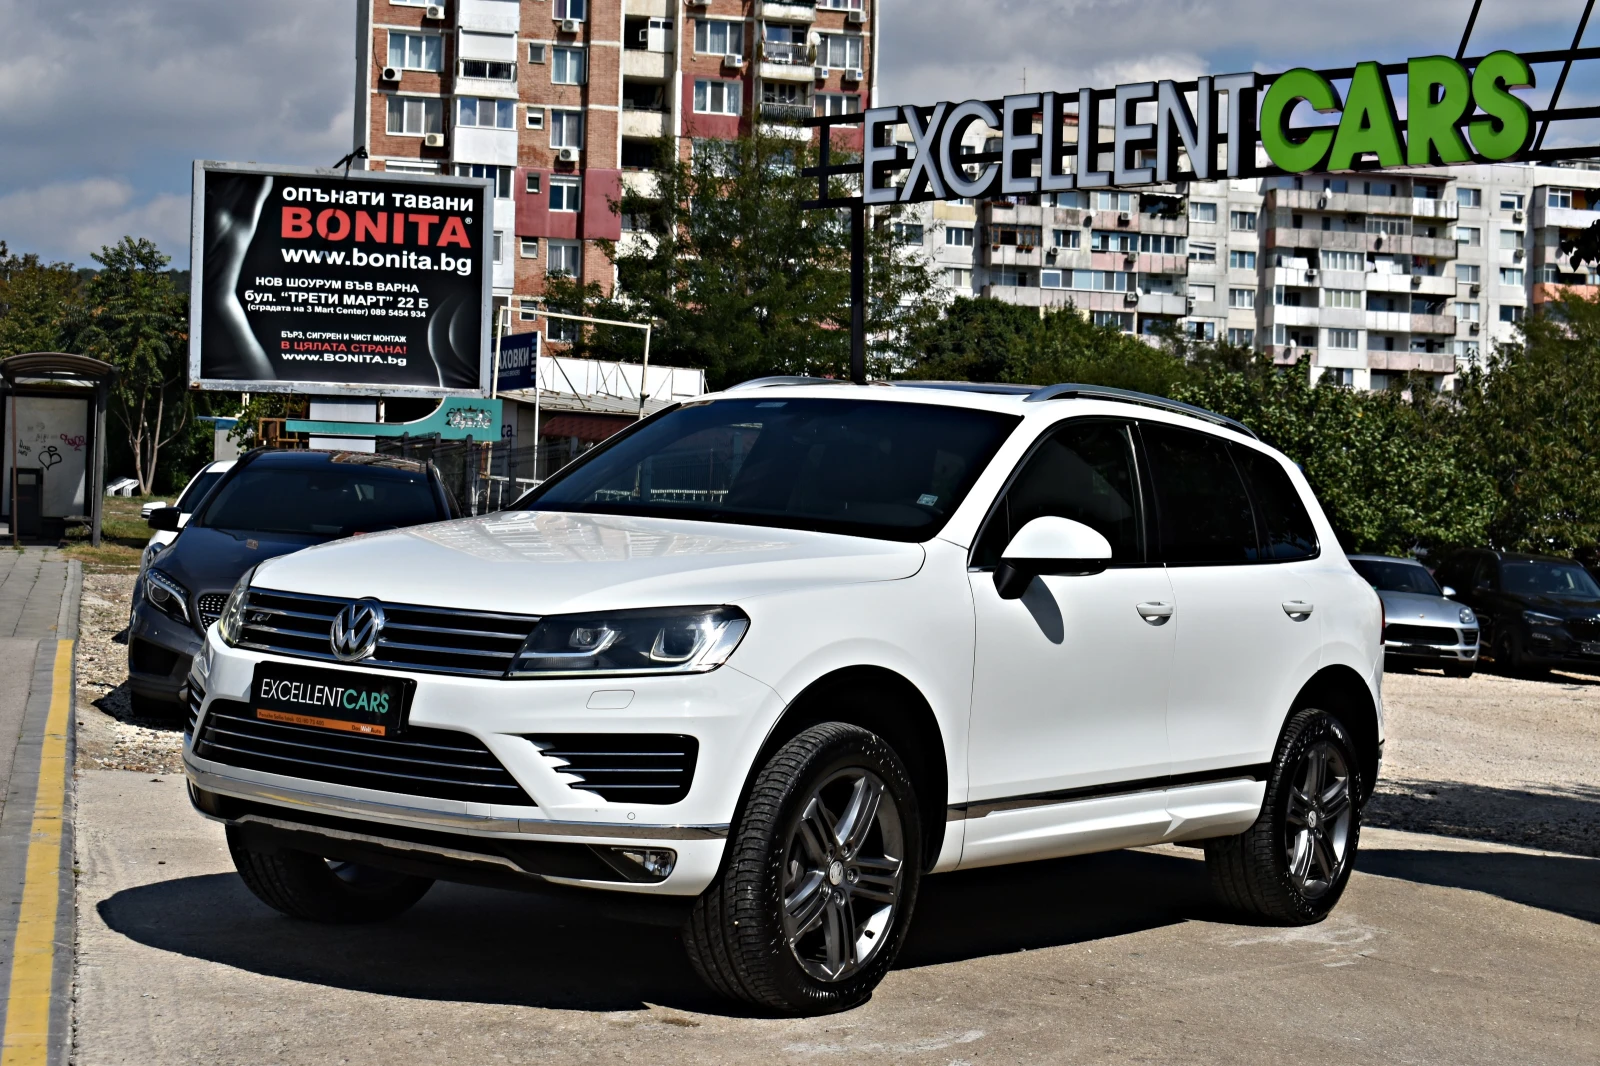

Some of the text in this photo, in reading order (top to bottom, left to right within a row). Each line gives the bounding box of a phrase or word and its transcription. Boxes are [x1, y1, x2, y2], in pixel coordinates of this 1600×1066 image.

[282, 187, 474, 212] опънати тавани
[281, 248, 472, 276] www.bonita.bg
[256, 277, 420, 293] НОВ ШОУРУМ ВЪВ ВАРНА
[244, 290, 276, 304] бул.
[397, 297, 414, 308] 22
[418, 298, 429, 309] Б
[247, 303, 291, 312] (сградата
[336, 307, 368, 316] Center)
[370, 308, 386, 316] 089
[388, 309, 409, 317] 5454
[410, 310, 426, 318] 934
[281, 331, 305, 339] БЪРЗ,
[306, 332, 342, 340] СИГУРЕН
[350, 333, 372, 342] ЧИСТ
[372, 334, 407, 343] МОНТАЖ
[281, 341, 407, 354] В ЦЯЛАТА СТРАНА!
[281, 353, 407, 367] www.BONITA.bg
